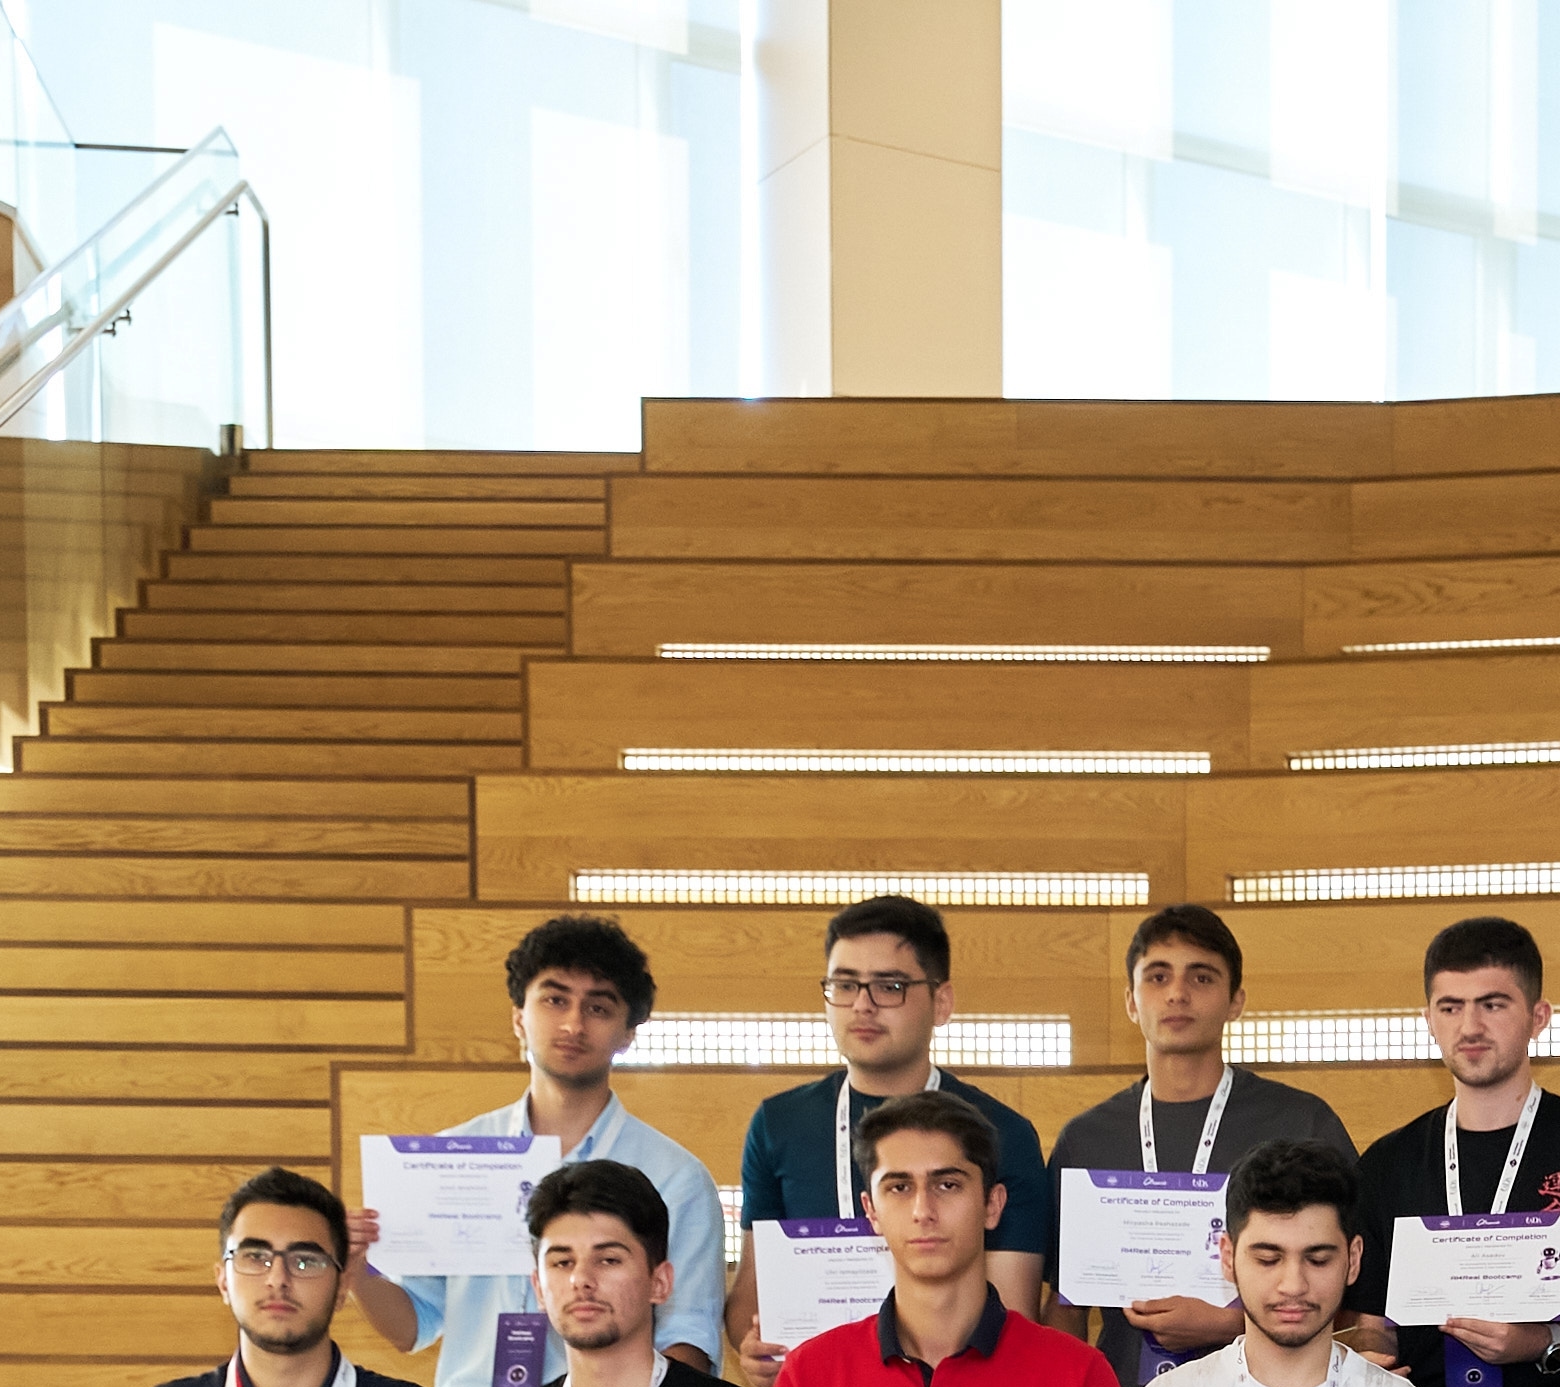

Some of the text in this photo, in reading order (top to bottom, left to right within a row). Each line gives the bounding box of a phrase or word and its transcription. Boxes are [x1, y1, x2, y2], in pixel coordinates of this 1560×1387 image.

[1100, 1197, 1149, 1205] Certificate
[1163, 1199, 1214, 1207] Completion
[1496, 1234, 1547, 1242] Completion
[794, 1247, 841, 1255] Certificate
